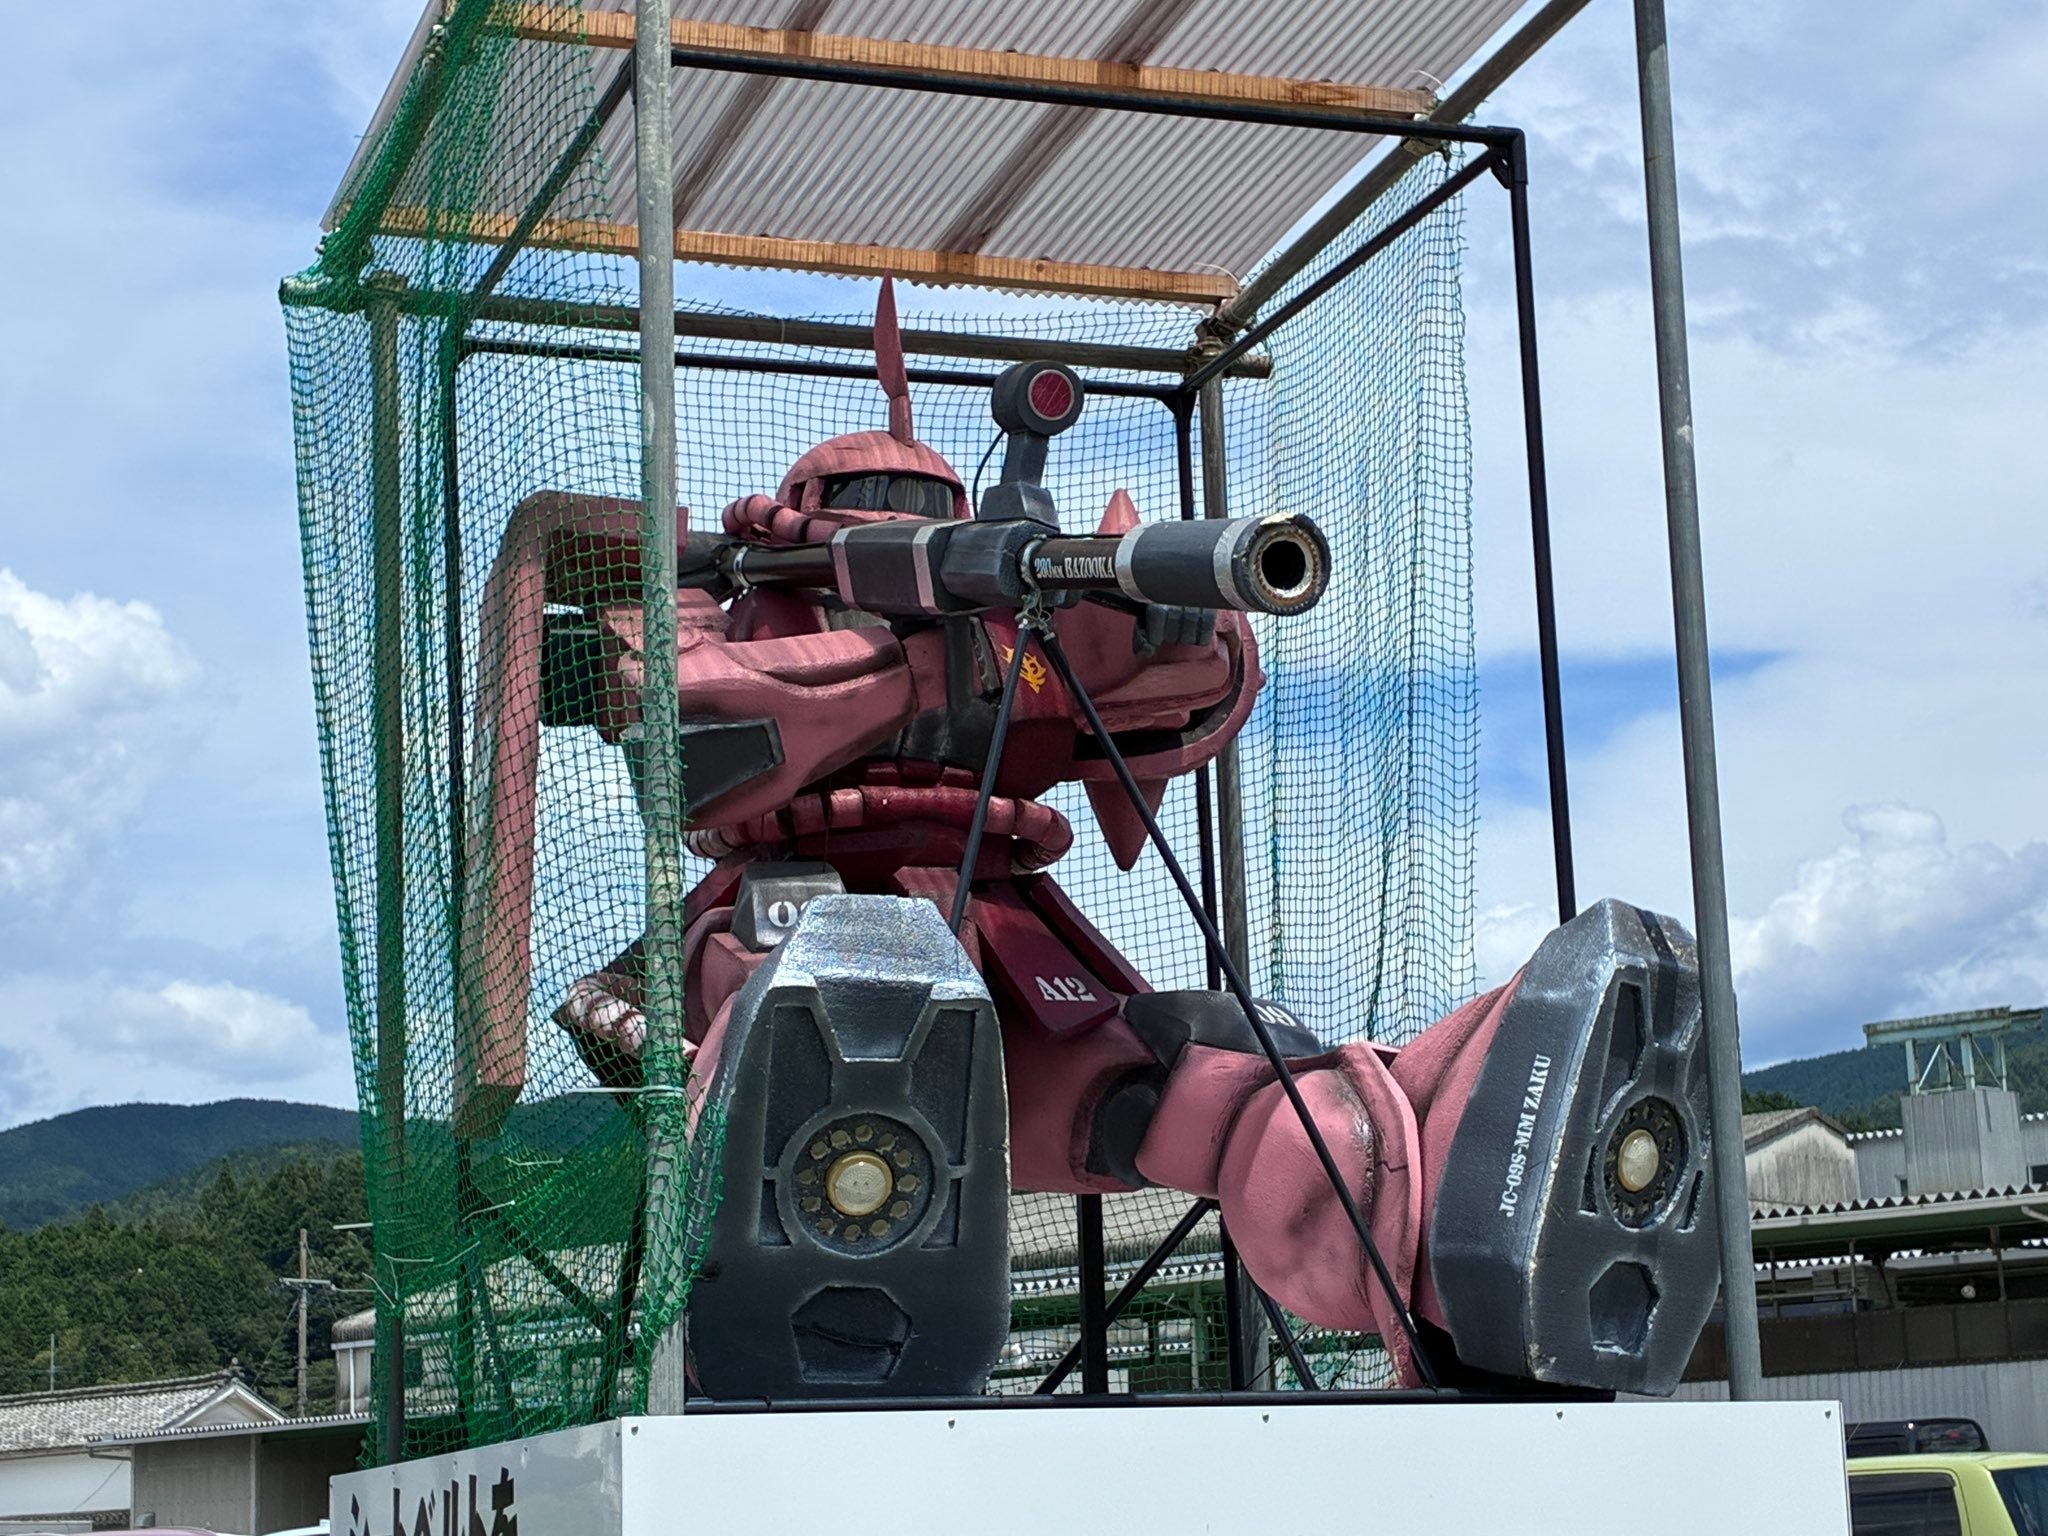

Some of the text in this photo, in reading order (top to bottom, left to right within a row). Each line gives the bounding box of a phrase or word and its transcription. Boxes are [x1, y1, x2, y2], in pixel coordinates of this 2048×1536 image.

[1064, 556, 1116, 579] BAZOOKA
[768, 901, 809, 930] 0
[1035, 976, 1097, 1001] A12
[1499, 1053, 1552, 1218] JC-09S-MM ZAKU
